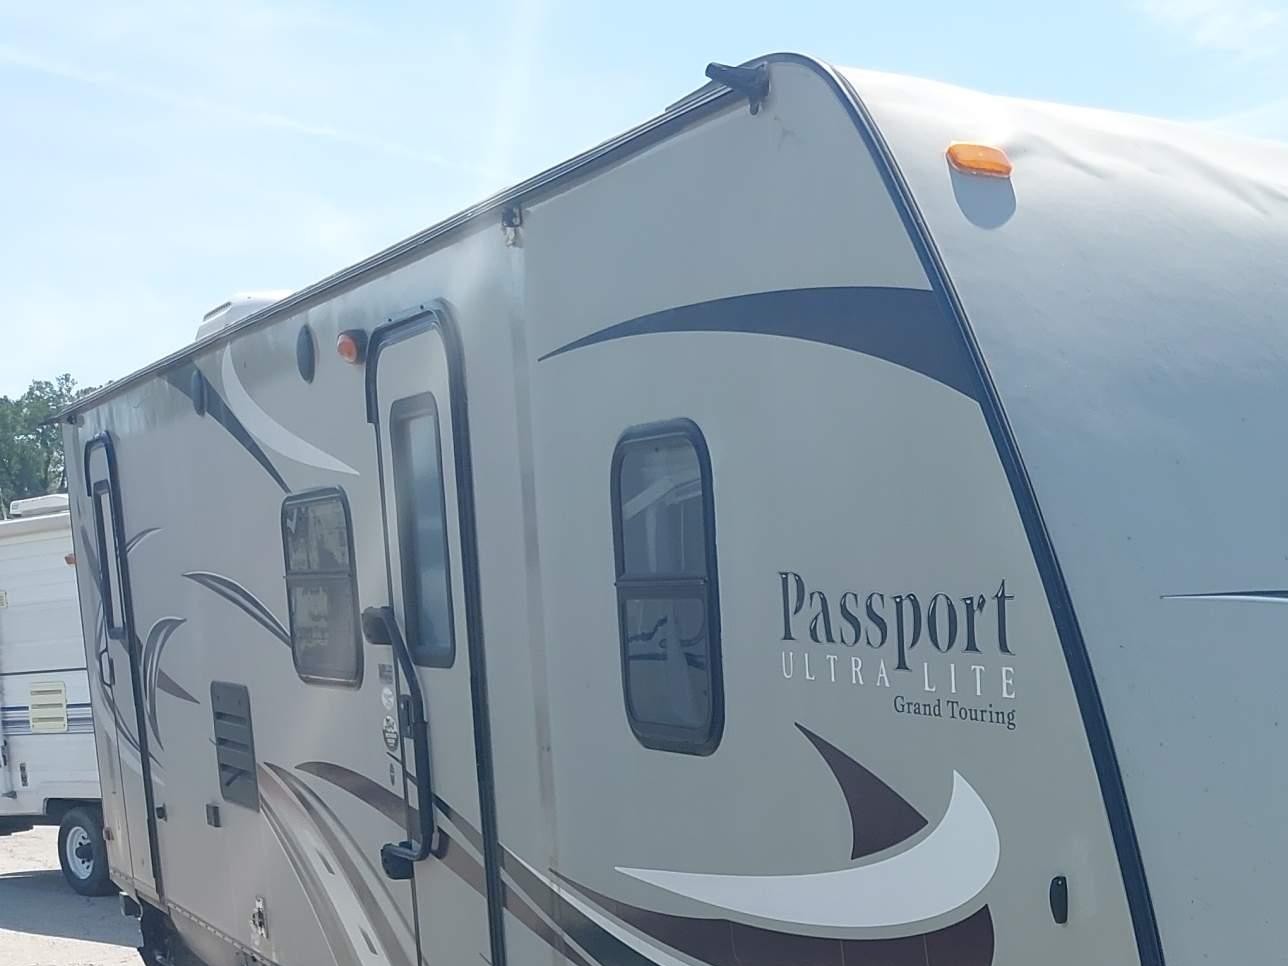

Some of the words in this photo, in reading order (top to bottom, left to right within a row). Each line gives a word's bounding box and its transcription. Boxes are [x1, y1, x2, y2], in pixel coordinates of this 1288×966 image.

[777, 570, 1016, 672] Passport
[781, 651, 891, 688] ULTRA
[922, 661, 1016, 699] LITE
[893, 695, 942, 718] Grand
[946, 700, 1017, 730] Touring
